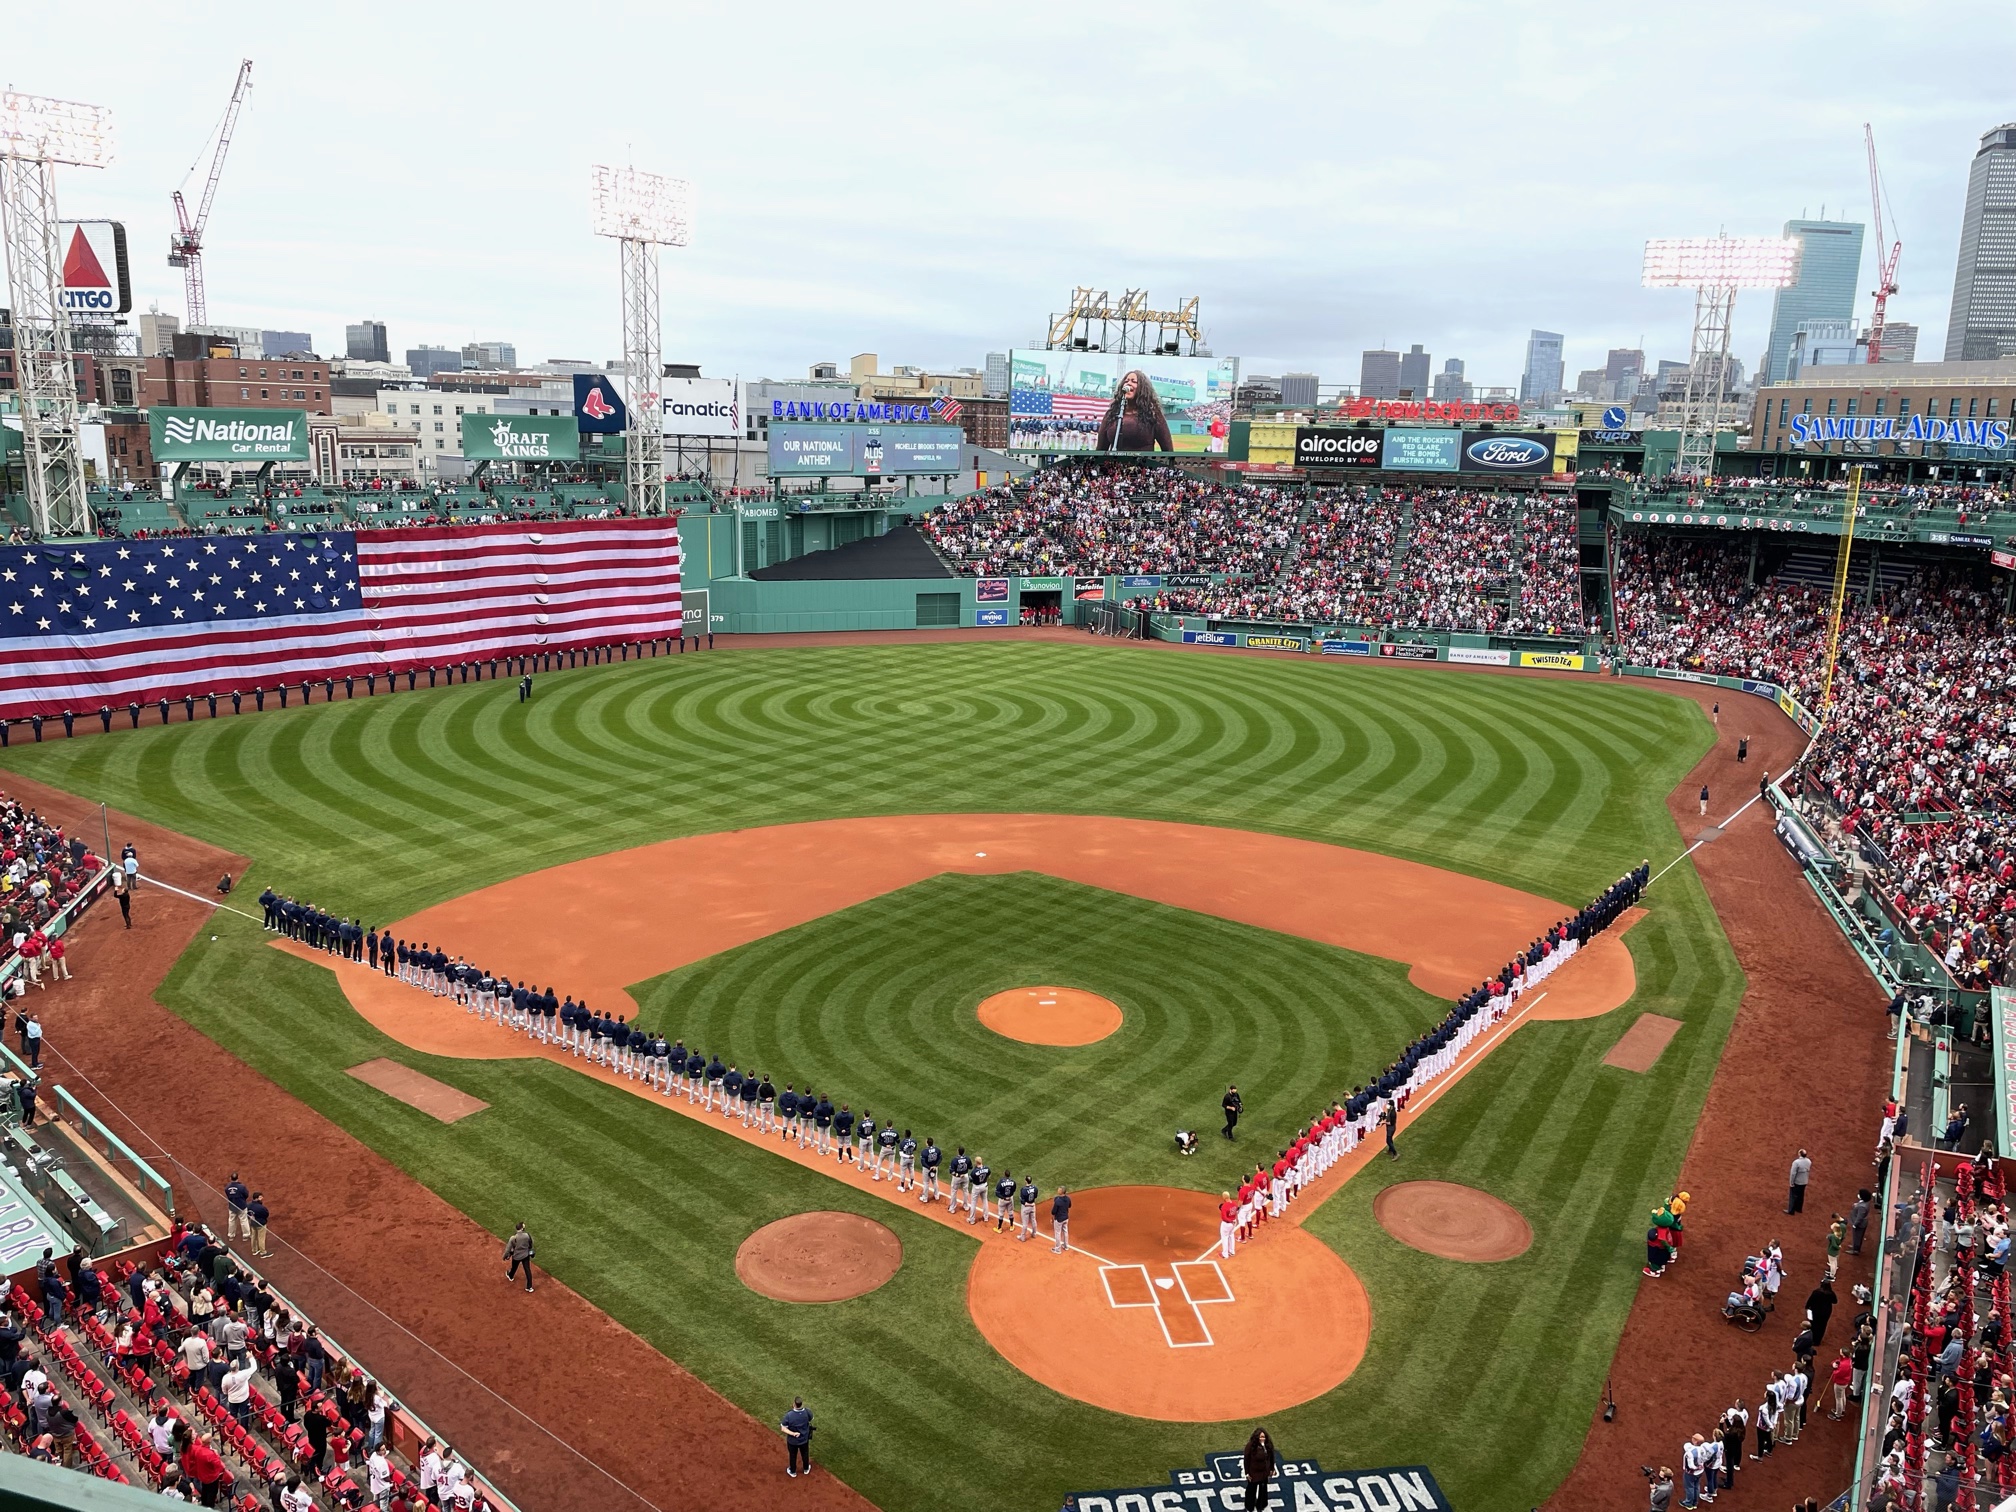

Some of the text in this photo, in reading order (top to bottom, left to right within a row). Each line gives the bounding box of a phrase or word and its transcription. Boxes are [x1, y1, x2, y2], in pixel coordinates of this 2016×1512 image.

[59, 290, 112, 308] CITGO
[1050, 286, 1201, 344] John Hancock
[663, 398, 735, 417] Fanatics
[773, 400, 931, 422] BANK OF AMERICA
[1377, 401, 1422, 418] new
[1424, 397, 1520, 421] balance
[1595, 431, 1631, 441] tyco
[1789, 413, 2010, 450] SAMUEL ADAMS
[494, 432, 550, 447] DRAFT
[1300, 434, 1379, 452] airocide
[232, 443, 291, 453] Car Rental
[502, 444, 549, 457] KINGS
[784, 441, 843, 452] OUR NATIONAL
[864, 447, 884, 460] ALDS
[1483, 442, 1533, 463] Ford
[797, 455, 831, 466] ANTHEM
[1300, 455, 1345, 463] DEVELOPED
[1435, 458, 1448, 466] AIR,
[744, 508, 778, 517] ABIOMED
[1950, 535, 1992, 545] SAMUEL ADAMS
[1030, 582, 1060, 590] sunovion
[1195, 633, 1224, 643] jetBlue
[1248, 637, 1301, 649] GRANITE CITY
[1531, 656, 1572, 667] TWISTED TEA
[25, 1380, 35, 1391] 34
[1177, 1463, 1317, 1485] 20 21
[438, 1476, 449, 1486] 41
[453, 1494, 466, 1505] 28
